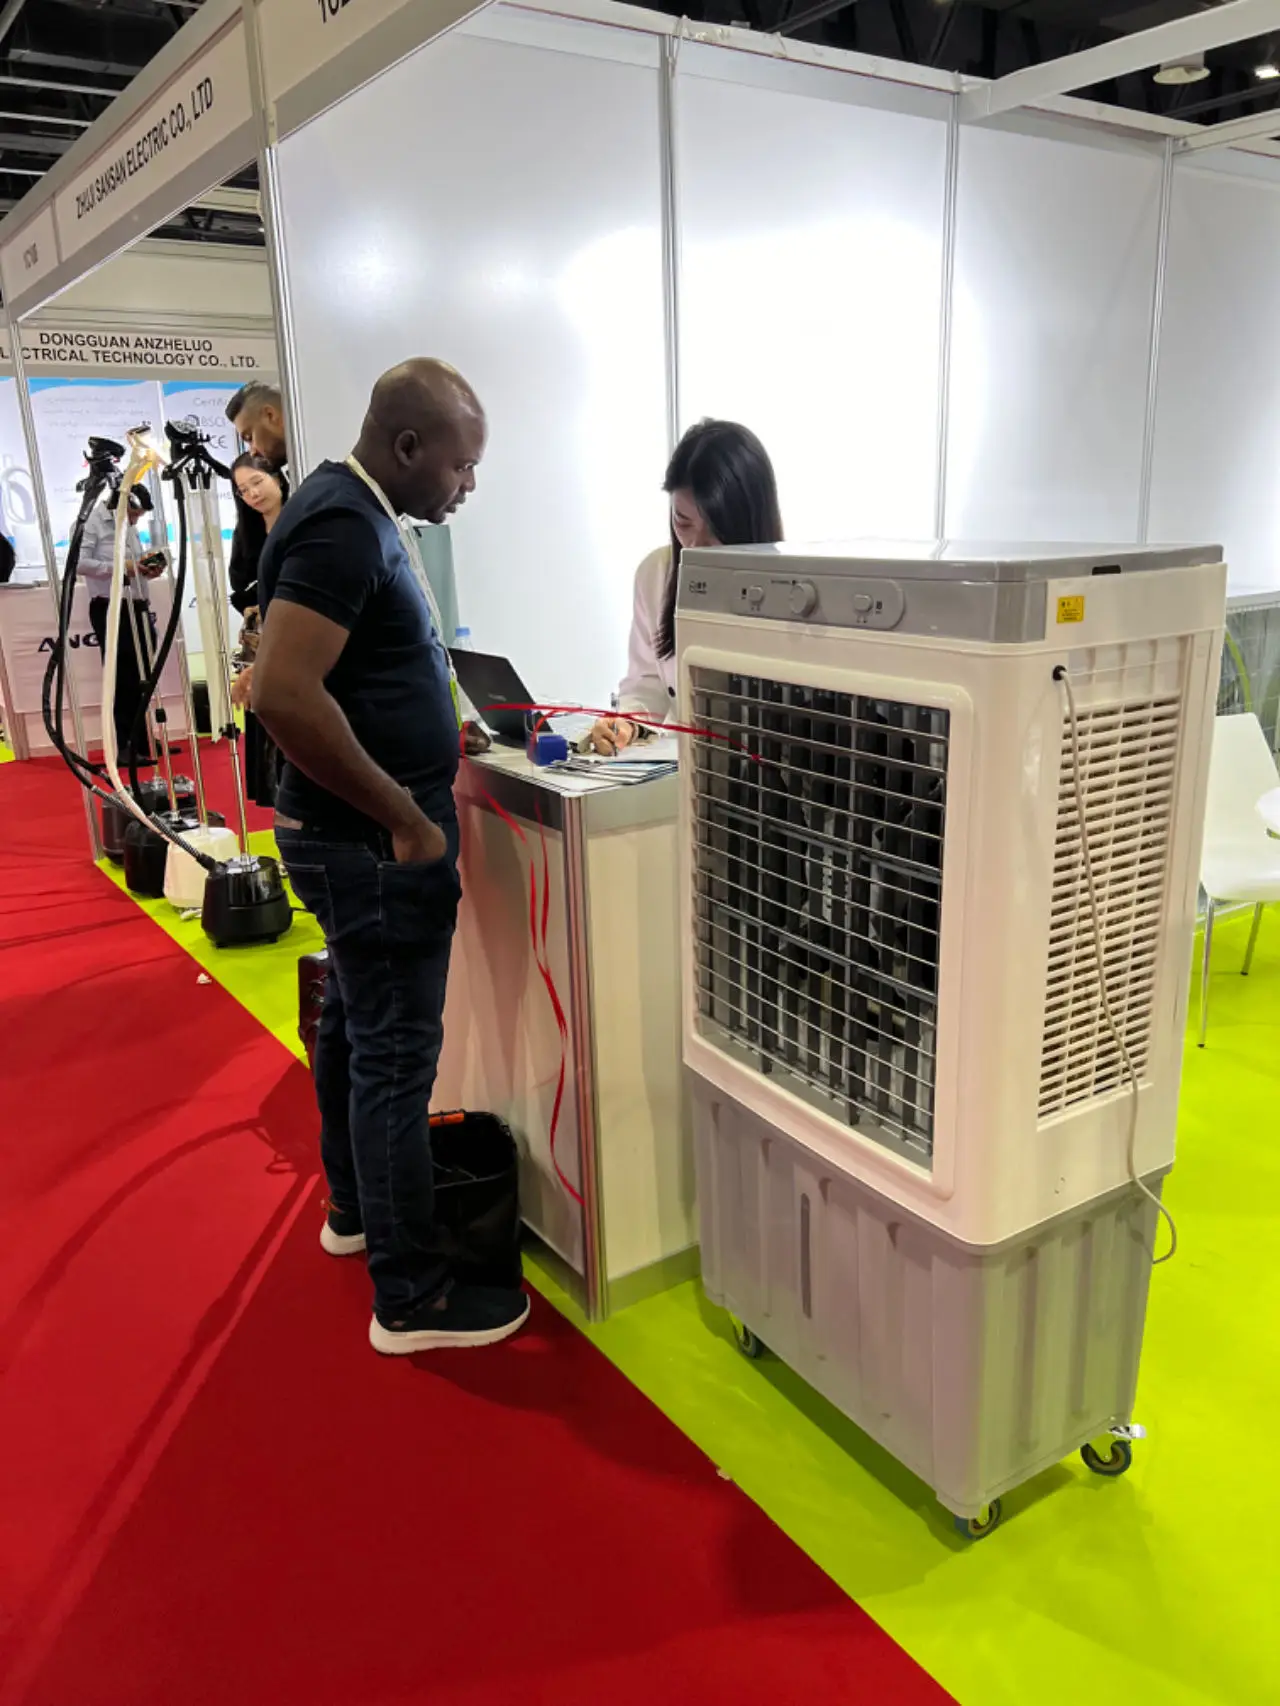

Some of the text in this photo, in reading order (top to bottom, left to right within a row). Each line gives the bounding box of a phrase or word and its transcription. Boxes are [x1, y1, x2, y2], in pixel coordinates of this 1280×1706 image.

[95, 152, 128, 202] SANSAN
[126, 117, 169, 176] ELECTRIC
[191, 77, 213, 120] LTD
[39, 332, 213, 352] DONGGUAN ANZHELUO
[0, 346, 88, 362] LCTRICAL
[91, 349, 195, 366] TECHNOLOGY
[230, 356, 260, 368] LTD.
